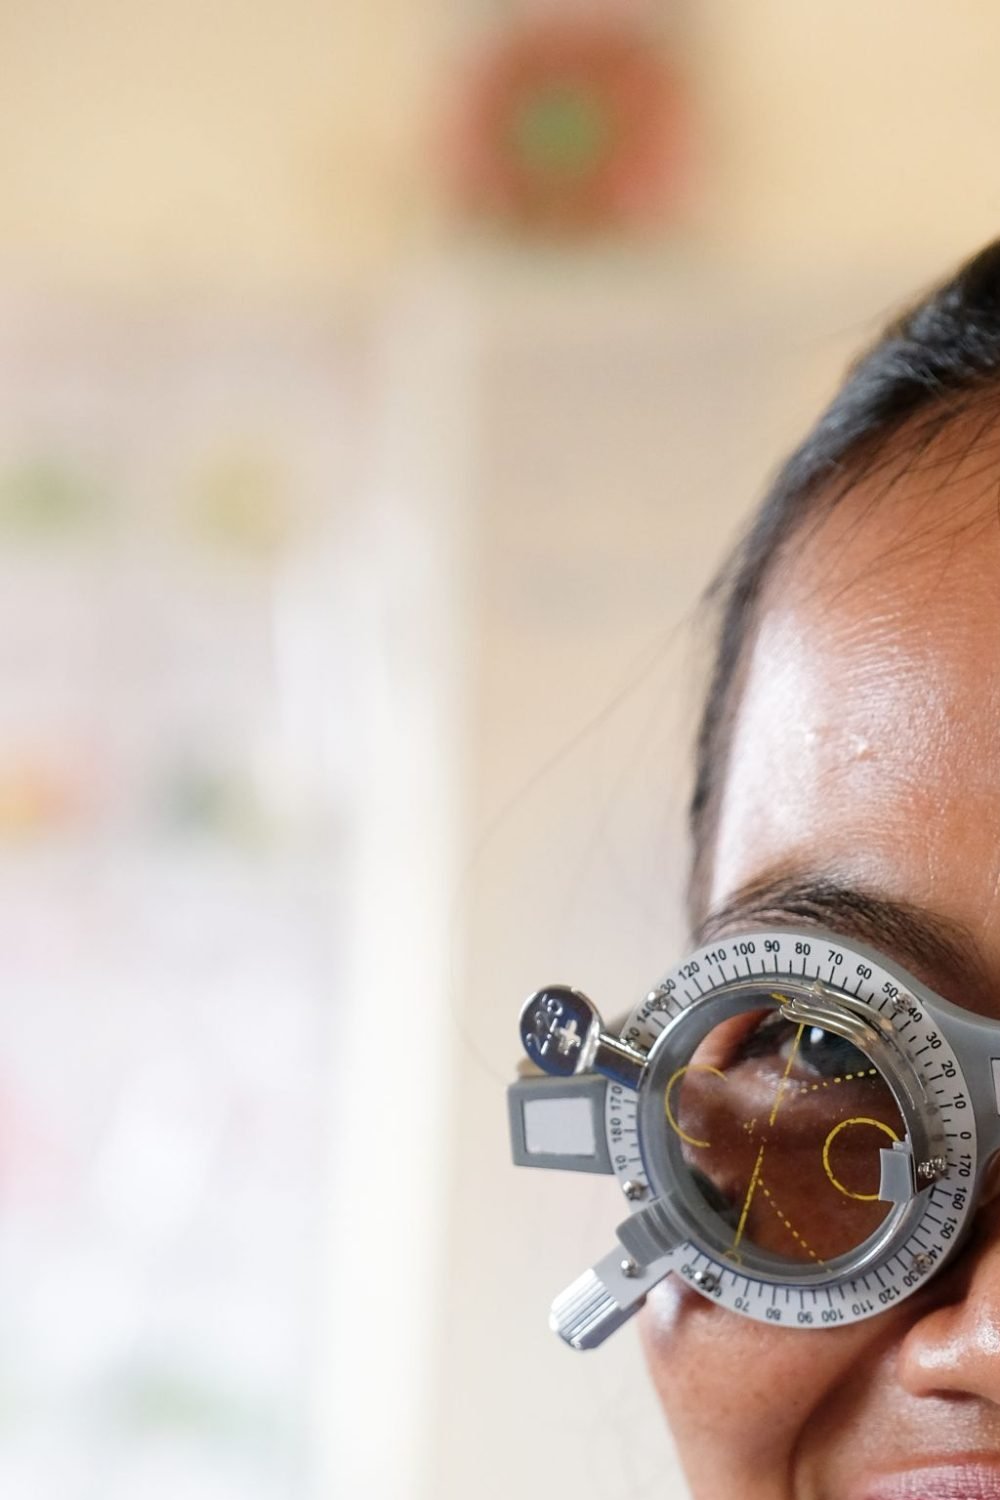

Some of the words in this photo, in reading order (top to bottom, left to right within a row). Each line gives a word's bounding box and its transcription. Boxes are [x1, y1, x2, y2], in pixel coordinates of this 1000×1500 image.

[732, 941, 756, 957] 100
[764, 940, 780, 953] 90
[795, 943, 811, 955] 80
[704, 948, 727, 966] 110
[828, 950, 843, 966] 70
[678, 961, 700, 980] 120
[856, 964, 872, 980] 60
[660, 978, 676, 995] 30
[882, 982, 898, 998] 50
[908, 1006, 923, 1023] 40
[926, 1031, 942, 1050] 30
[941, 1060, 956, 1078] 20
[610, 1085, 623, 1111] 170
[953, 1093, 967, 1109] 10
[610, 1117, 623, 1143] 180
[960, 1131, 972, 1140] 0
[615, 1154, 628, 1171] 10
[958, 1153, 972, 1178] 170
[952, 1186, 967, 1210] 160
[940, 1216, 958, 1239] 150
[902, 1270, 919, 1287] 30
[878, 1285, 900, 1305] 120
[734, 1297, 749, 1313] 70
[852, 1299, 874, 1315] 110
[766, 1307, 781, 1321] 80
[797, 1311, 813, 1323] 90
[821, 1309, 844, 1322] 100
